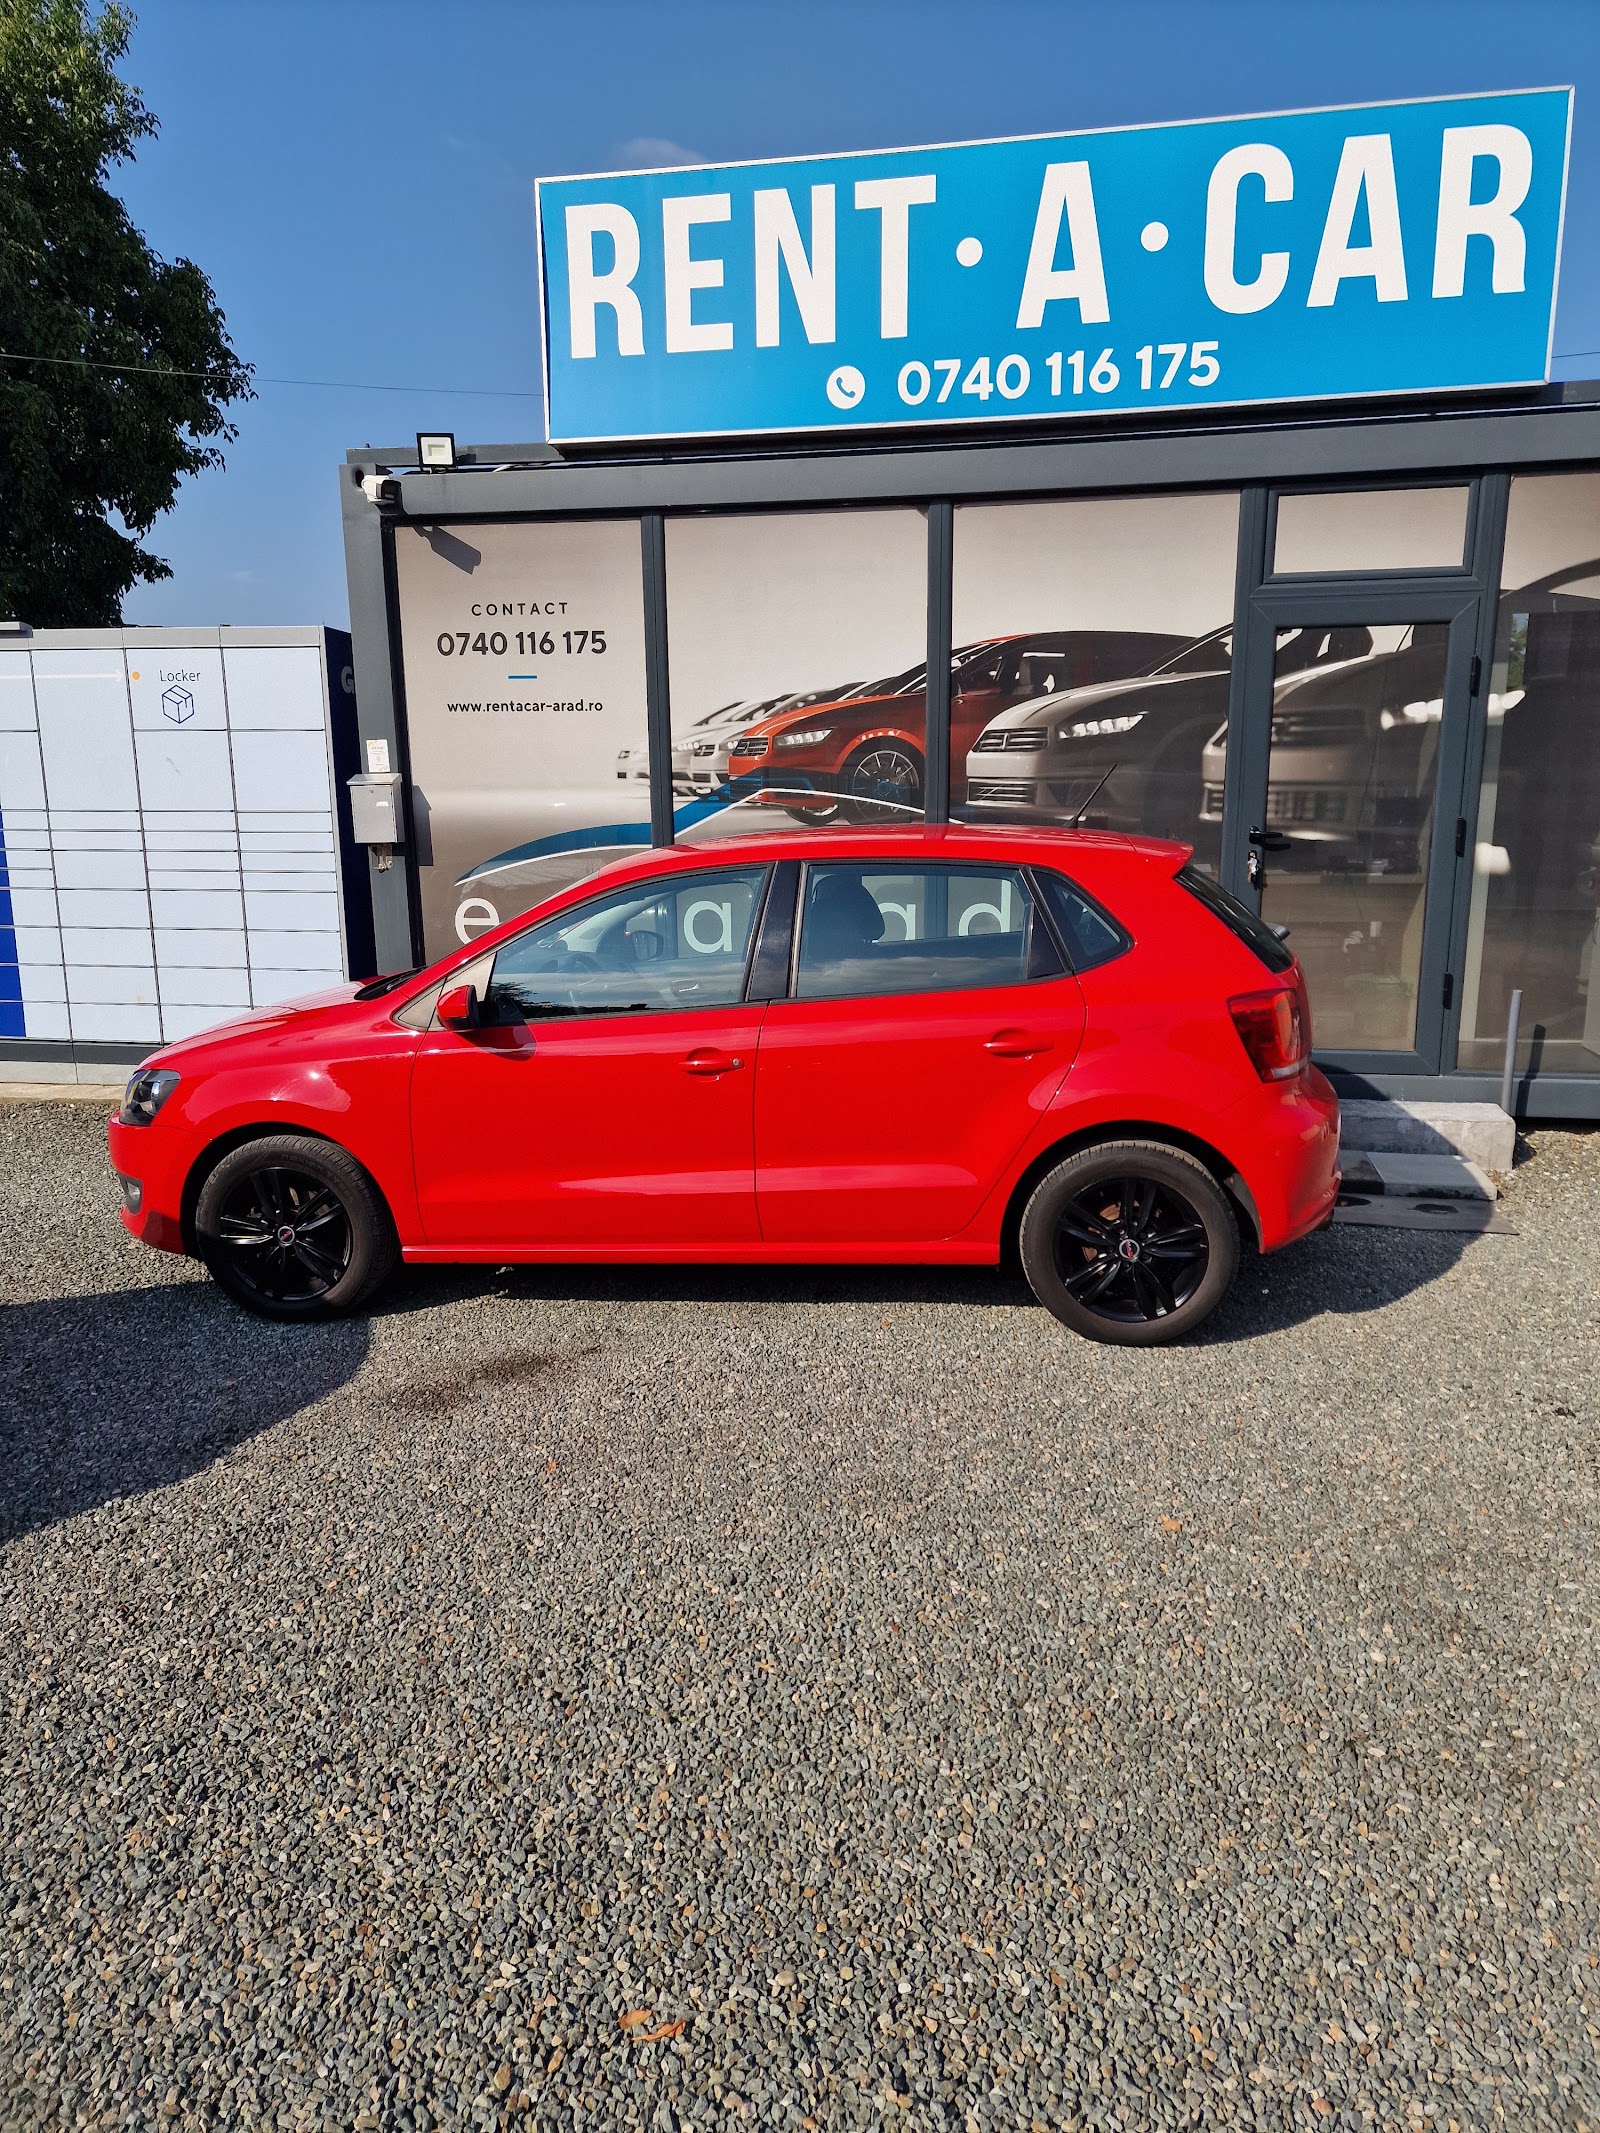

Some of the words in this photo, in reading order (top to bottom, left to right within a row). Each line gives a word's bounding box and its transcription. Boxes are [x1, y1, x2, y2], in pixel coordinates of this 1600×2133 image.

[897, 353, 1031, 406] 0740
[1045, 348, 1120, 396] 116
[1135, 340, 1220, 390] 175
[471, 602, 569, 617] CONTACT
[436, 631, 508, 657] 0740
[515, 631, 556, 655] 116
[562, 630, 607, 655] 175
[159, 669, 201, 682] Locker
[447, 699, 604, 713] www.rentacar-arad.ro
